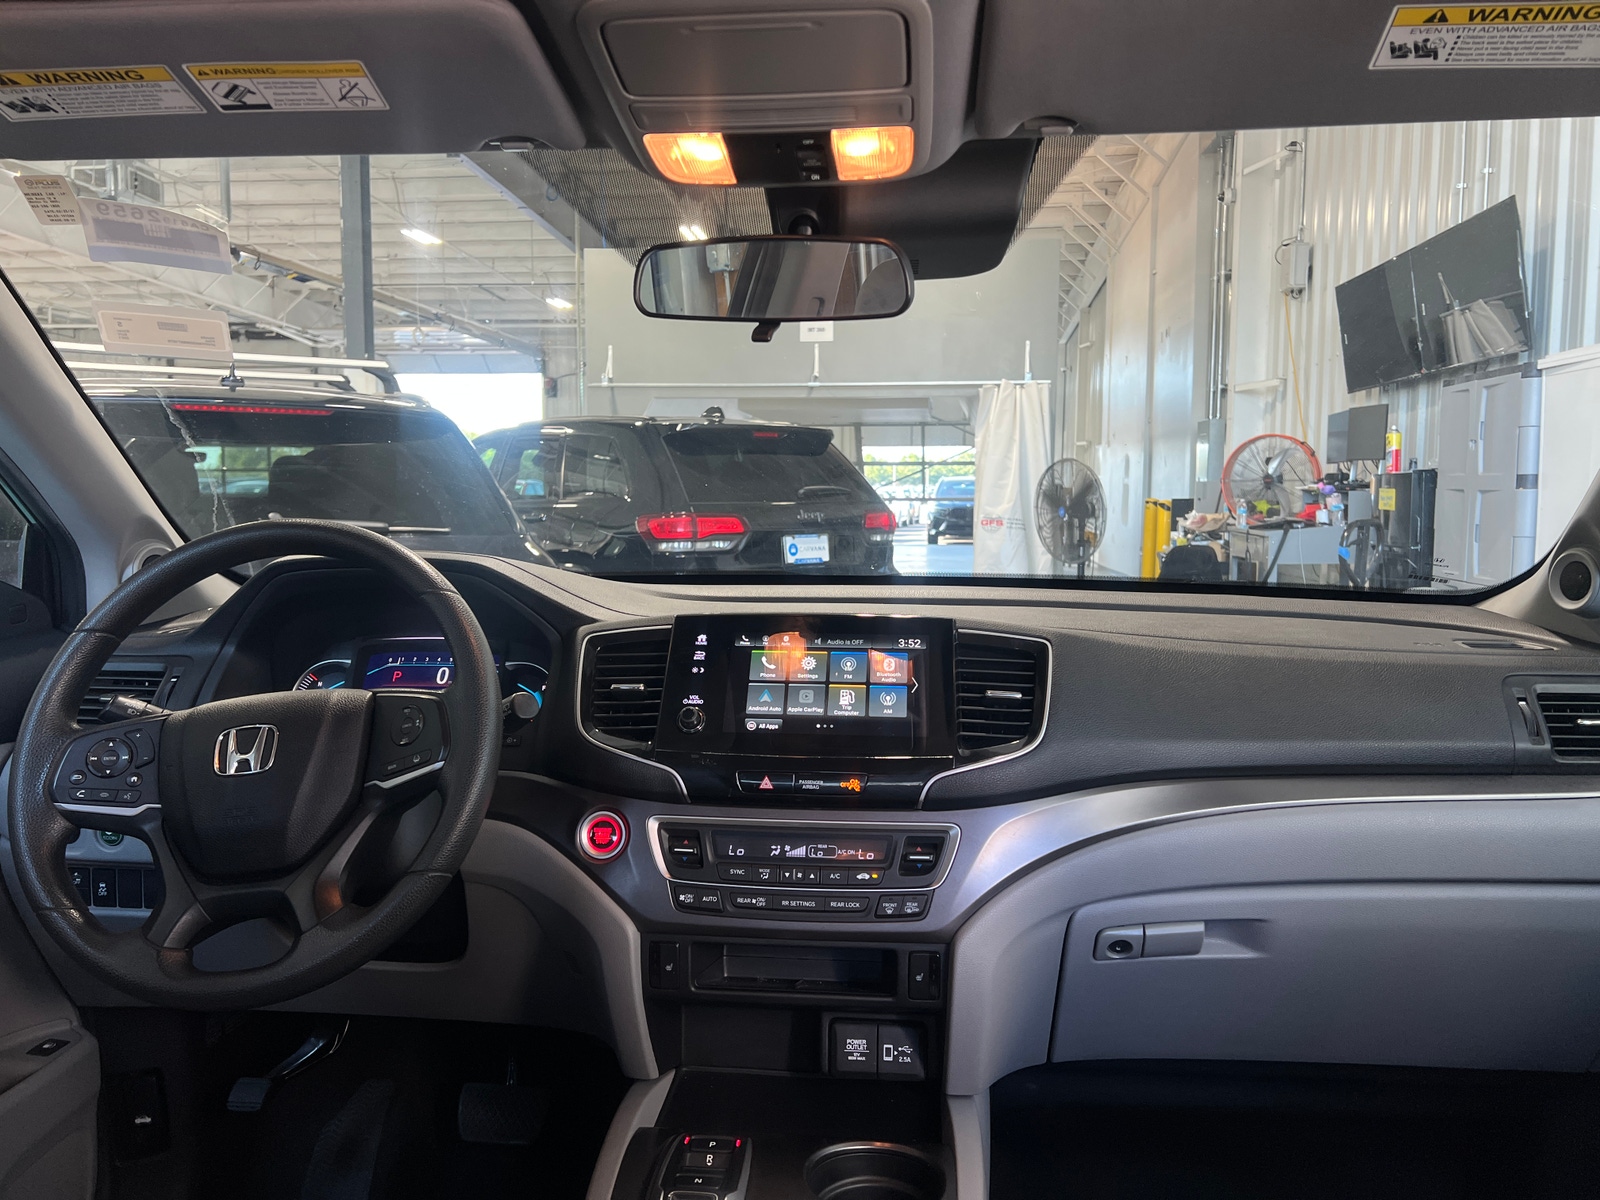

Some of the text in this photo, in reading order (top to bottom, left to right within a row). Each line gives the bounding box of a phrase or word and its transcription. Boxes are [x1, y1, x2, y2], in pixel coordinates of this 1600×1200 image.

[1467, 5, 1600, 22] WARNING
[1410, 27, 1443, 35] EVEN
[1446, 26, 1477, 34] WITH
[1477, 25, 1545, 33] ADVANCED
[211, 66, 277, 76] WARNING
[26, 70, 145, 84] WARNING
[57, 84, 112, 92] ADVANCED
[981, 519, 1004, 527] GFS
[898, 638, 921, 648] 3:52
[392, 666, 450, 685] P 0
[706, 1154, 714, 1163] R
